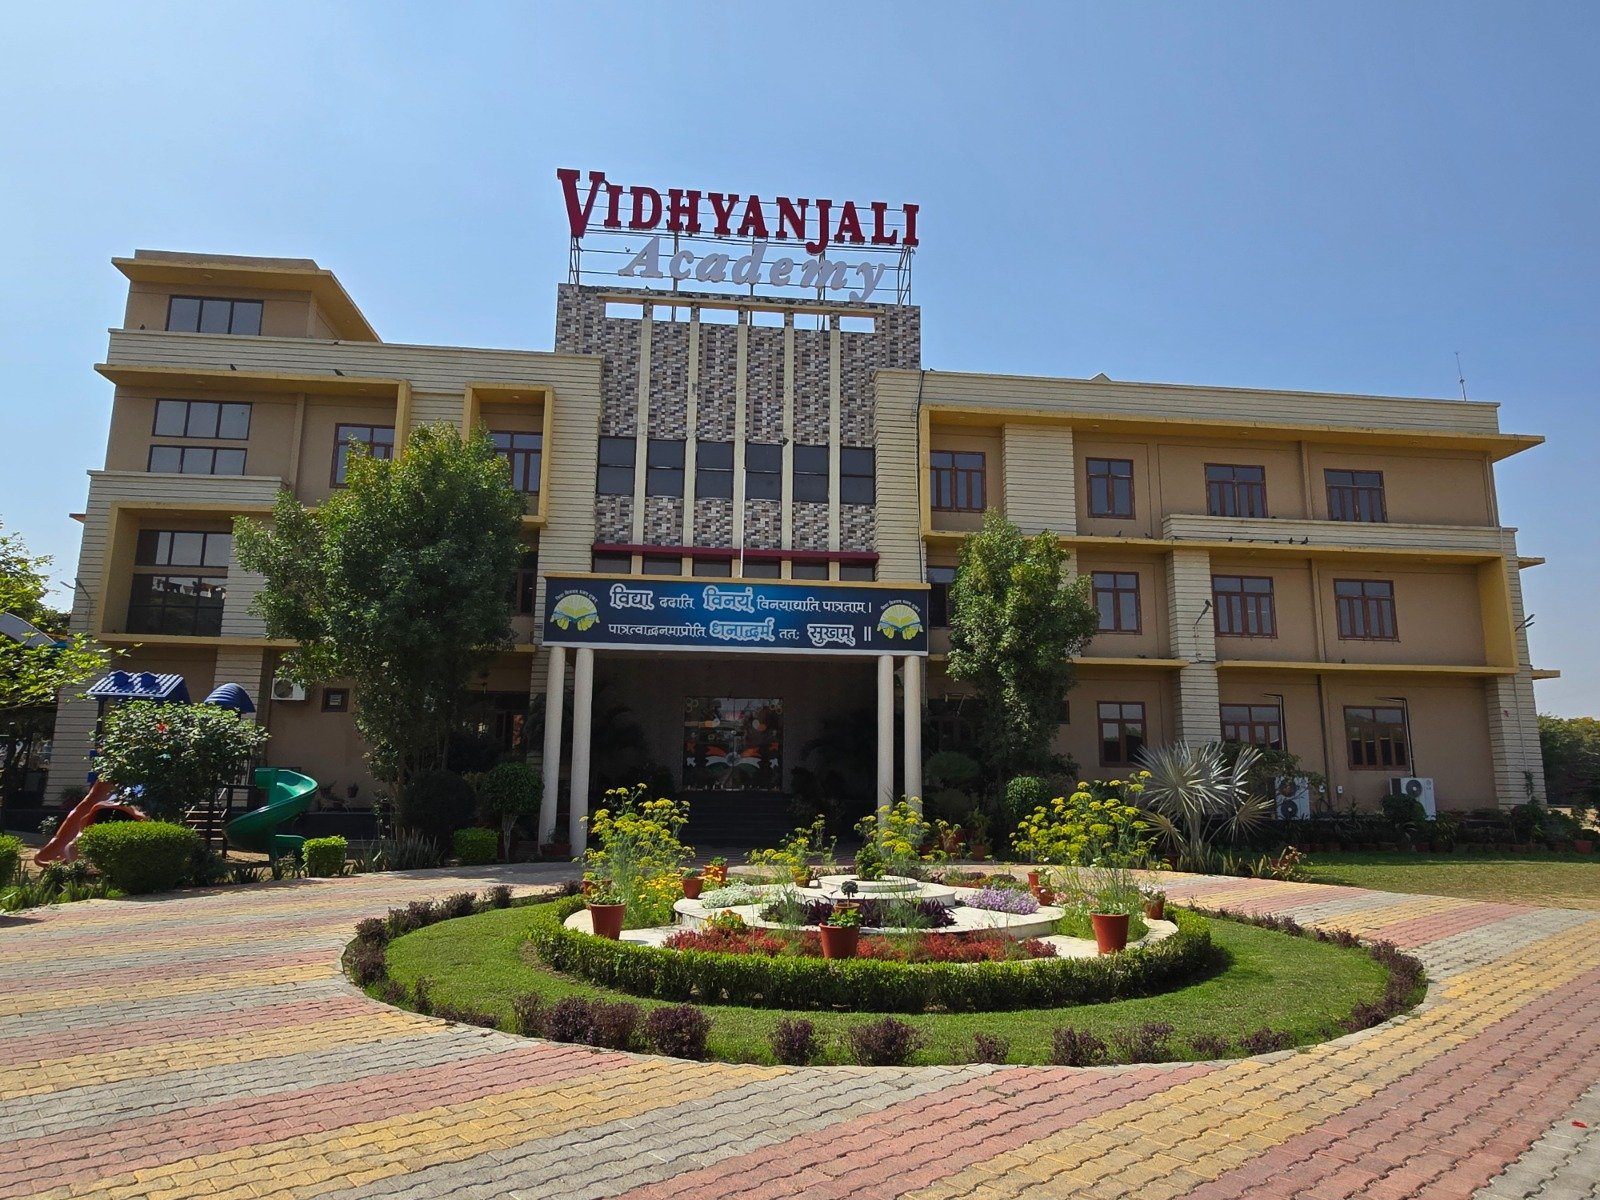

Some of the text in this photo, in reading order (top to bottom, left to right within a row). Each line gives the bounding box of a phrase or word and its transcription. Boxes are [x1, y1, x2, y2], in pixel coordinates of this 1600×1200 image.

[556, 168, 920, 255] VIDHYANJALI
[617, 236, 886, 302] Academy
[609, 583, 655, 611] विद्या
[659, 594, 695, 610] ददाति
[702, 585, 755, 614] विनयं
